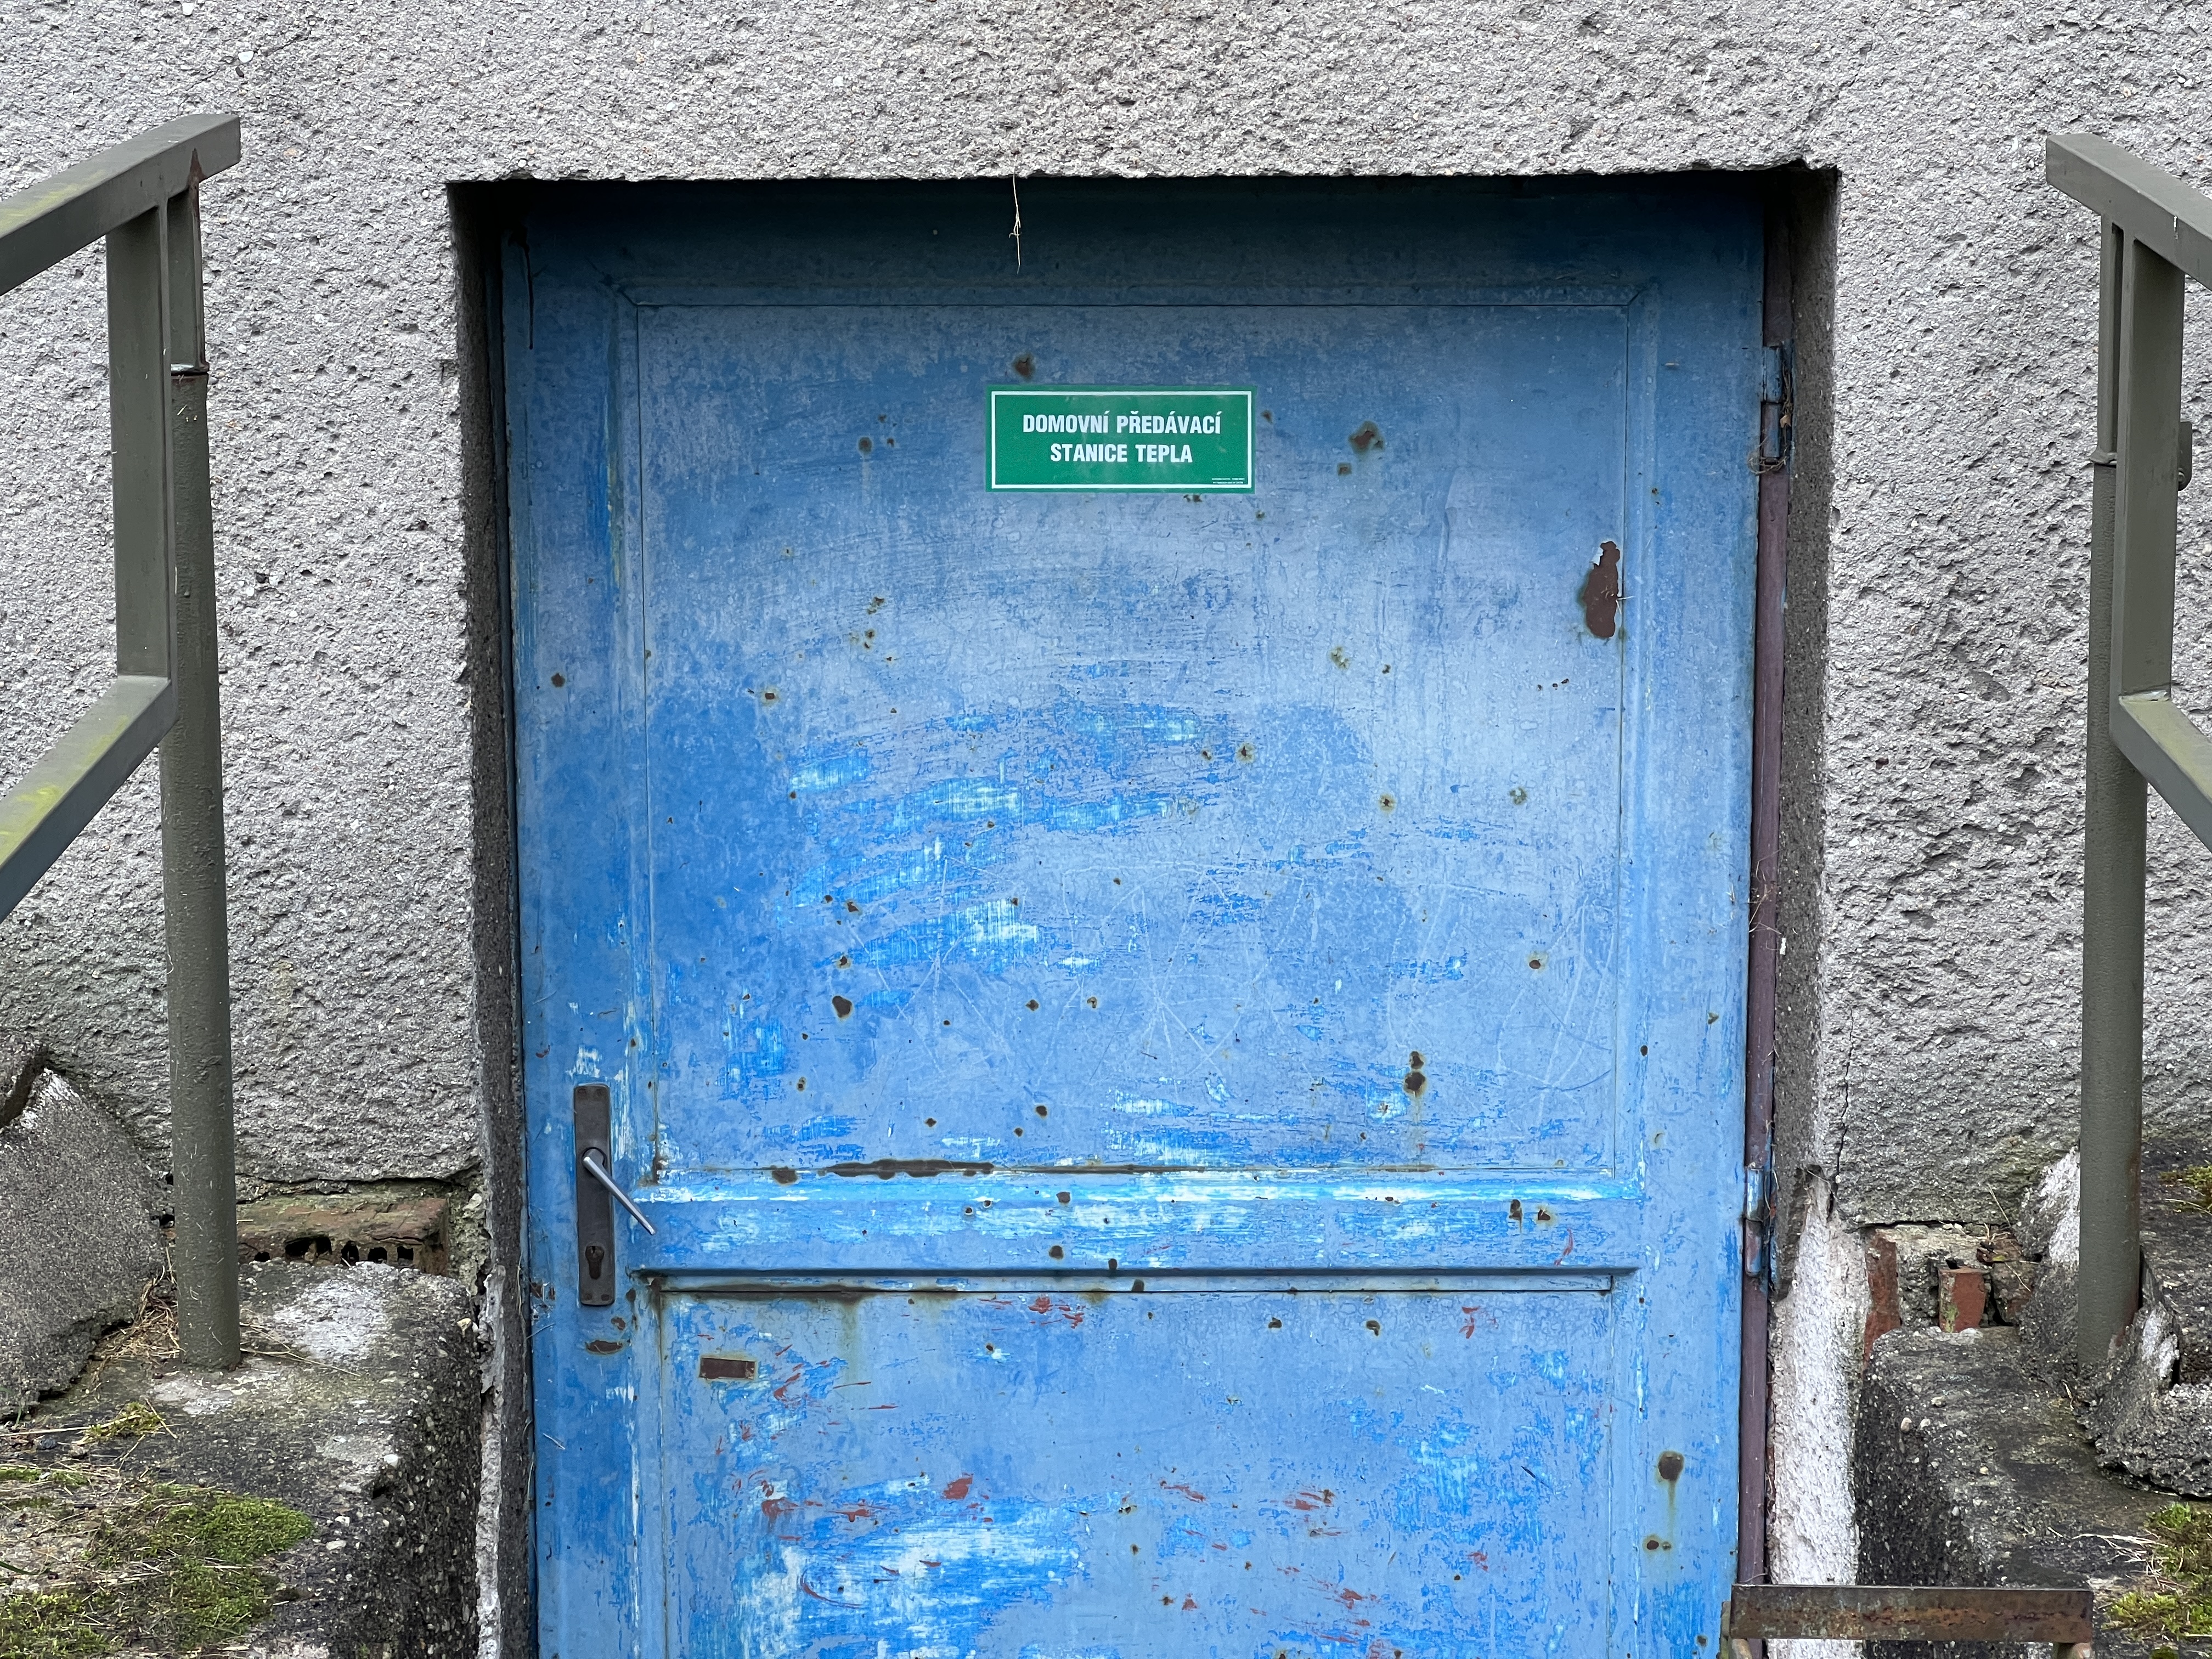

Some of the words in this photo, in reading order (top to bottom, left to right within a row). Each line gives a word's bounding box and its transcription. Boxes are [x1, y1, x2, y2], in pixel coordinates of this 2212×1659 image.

[1023, 410, 1110, 433] DOMOVNÍ
[1116, 410, 1222, 435] PŘEDÁVACÍ
[1050, 443, 1128, 463] STANICE
[1135, 444, 1193, 464] TEPLA
